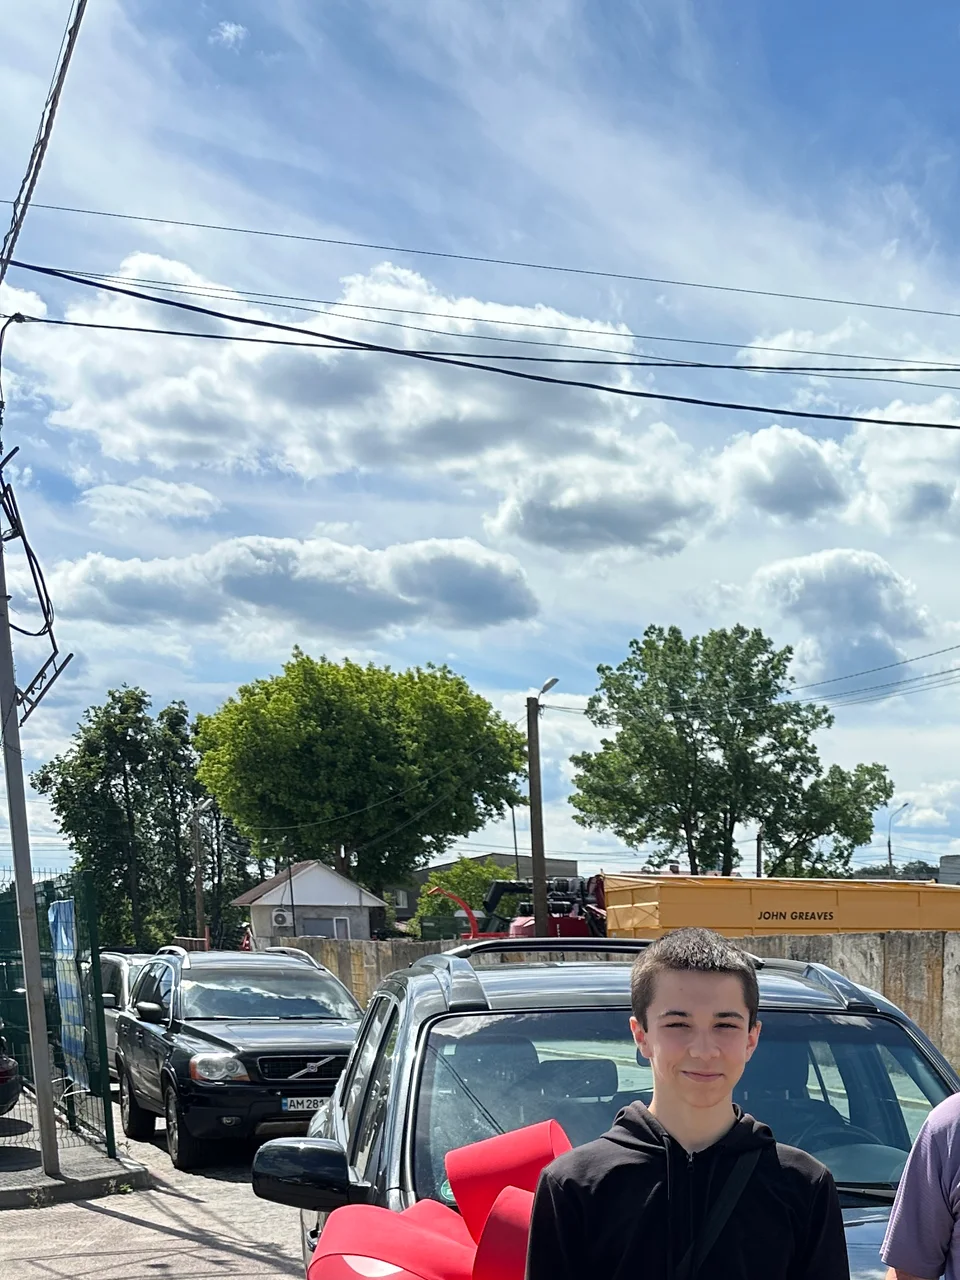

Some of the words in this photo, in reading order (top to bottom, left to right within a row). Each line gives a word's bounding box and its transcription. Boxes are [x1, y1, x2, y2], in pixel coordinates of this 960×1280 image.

[757, 911, 787, 920] JOHN
[790, 911, 834, 920] GREAVES
[289, 1099, 305, 1109] AM
[306, 1099, 325, 1109] 281
